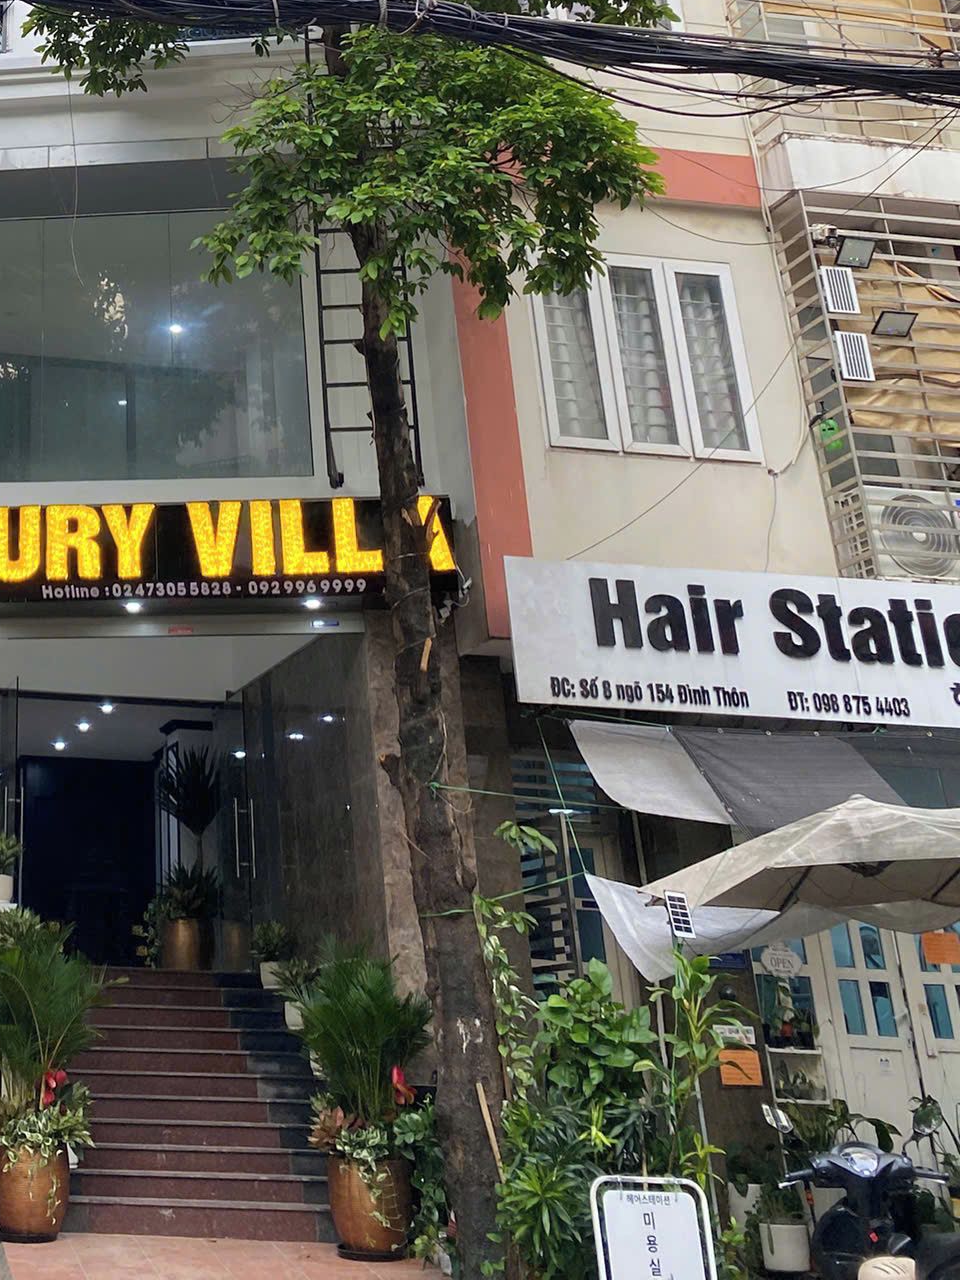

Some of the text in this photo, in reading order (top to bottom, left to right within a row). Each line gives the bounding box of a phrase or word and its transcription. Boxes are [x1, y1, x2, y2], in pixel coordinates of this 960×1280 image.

[588, 577, 744, 655] Hair
[550, 676, 911, 717] ĐC: Số 8 ngõ 154 Đình Thôn ĐT: 098 875 4403
[770, 957, 794, 969] OPEN
[643, 1211, 662, 1277] 미용실
